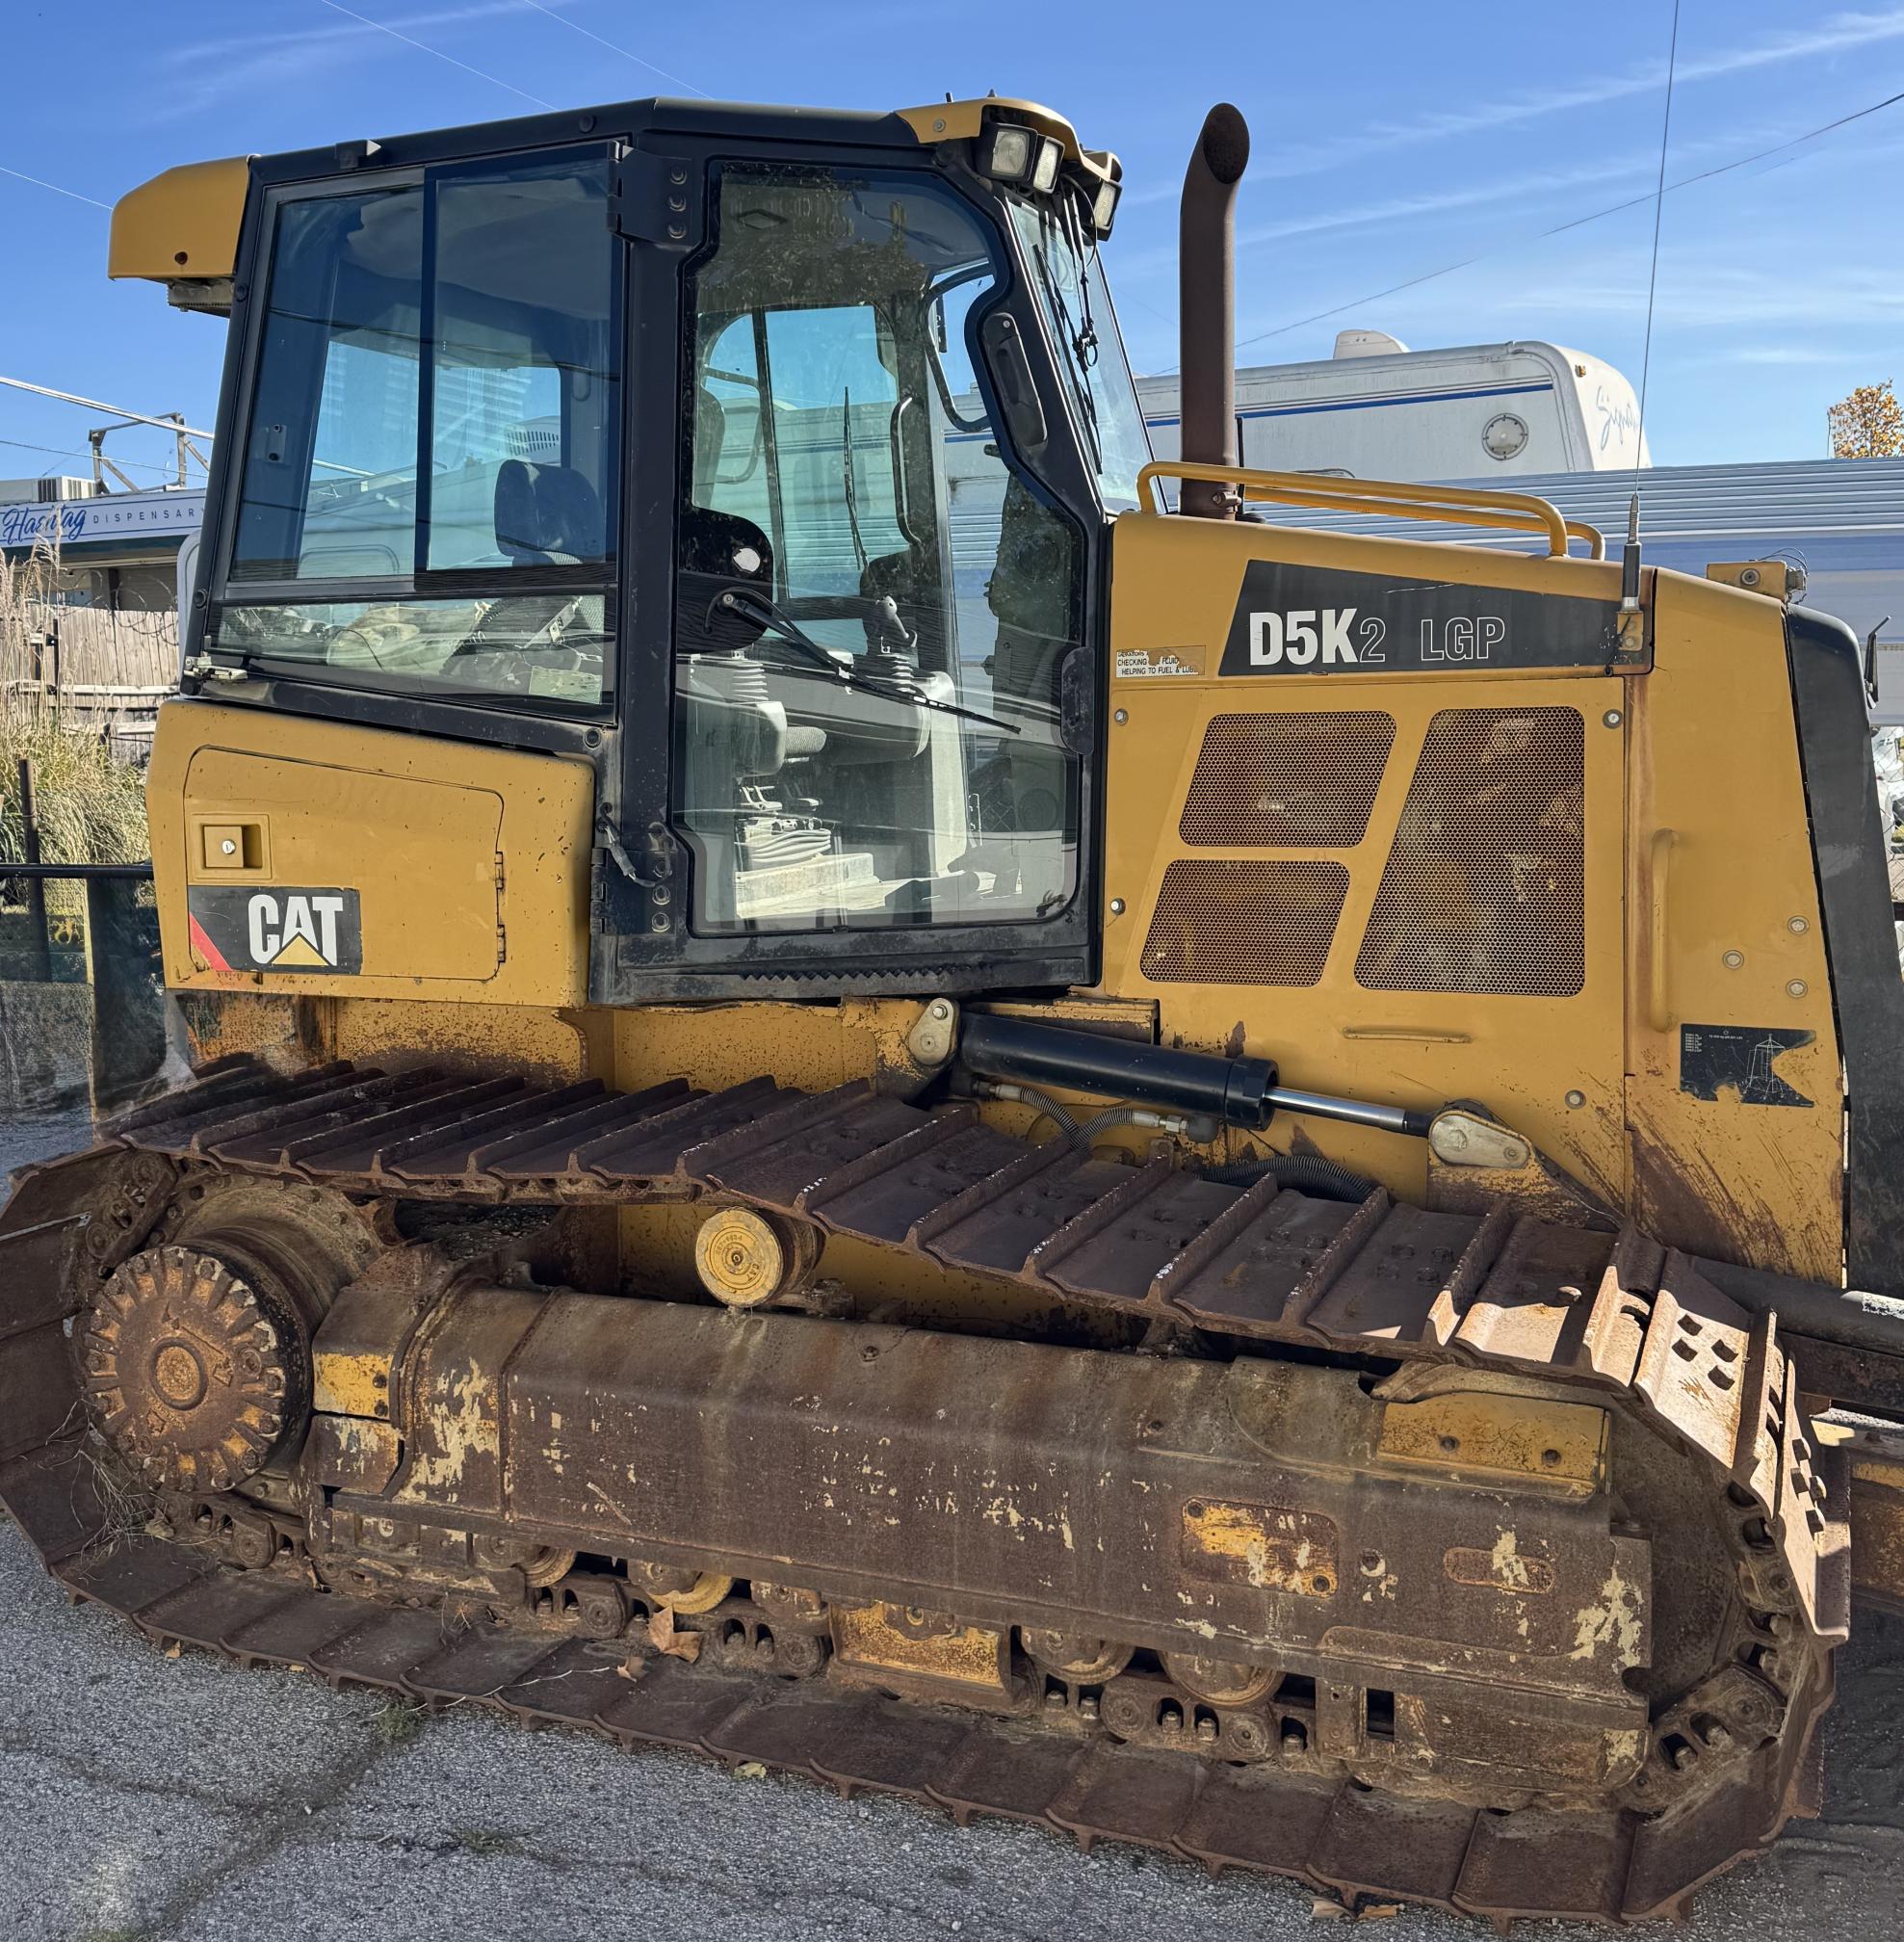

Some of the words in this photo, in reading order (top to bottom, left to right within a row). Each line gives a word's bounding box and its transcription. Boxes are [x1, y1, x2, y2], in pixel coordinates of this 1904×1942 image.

[92, 508, 204, 524] DISPENSAR
[1421, 617, 1505, 662] LGP
[1117, 658, 1147, 667] CHECKING
[1121, 667, 1146, 675] HELPING
[248, 894, 344, 966] CAT
